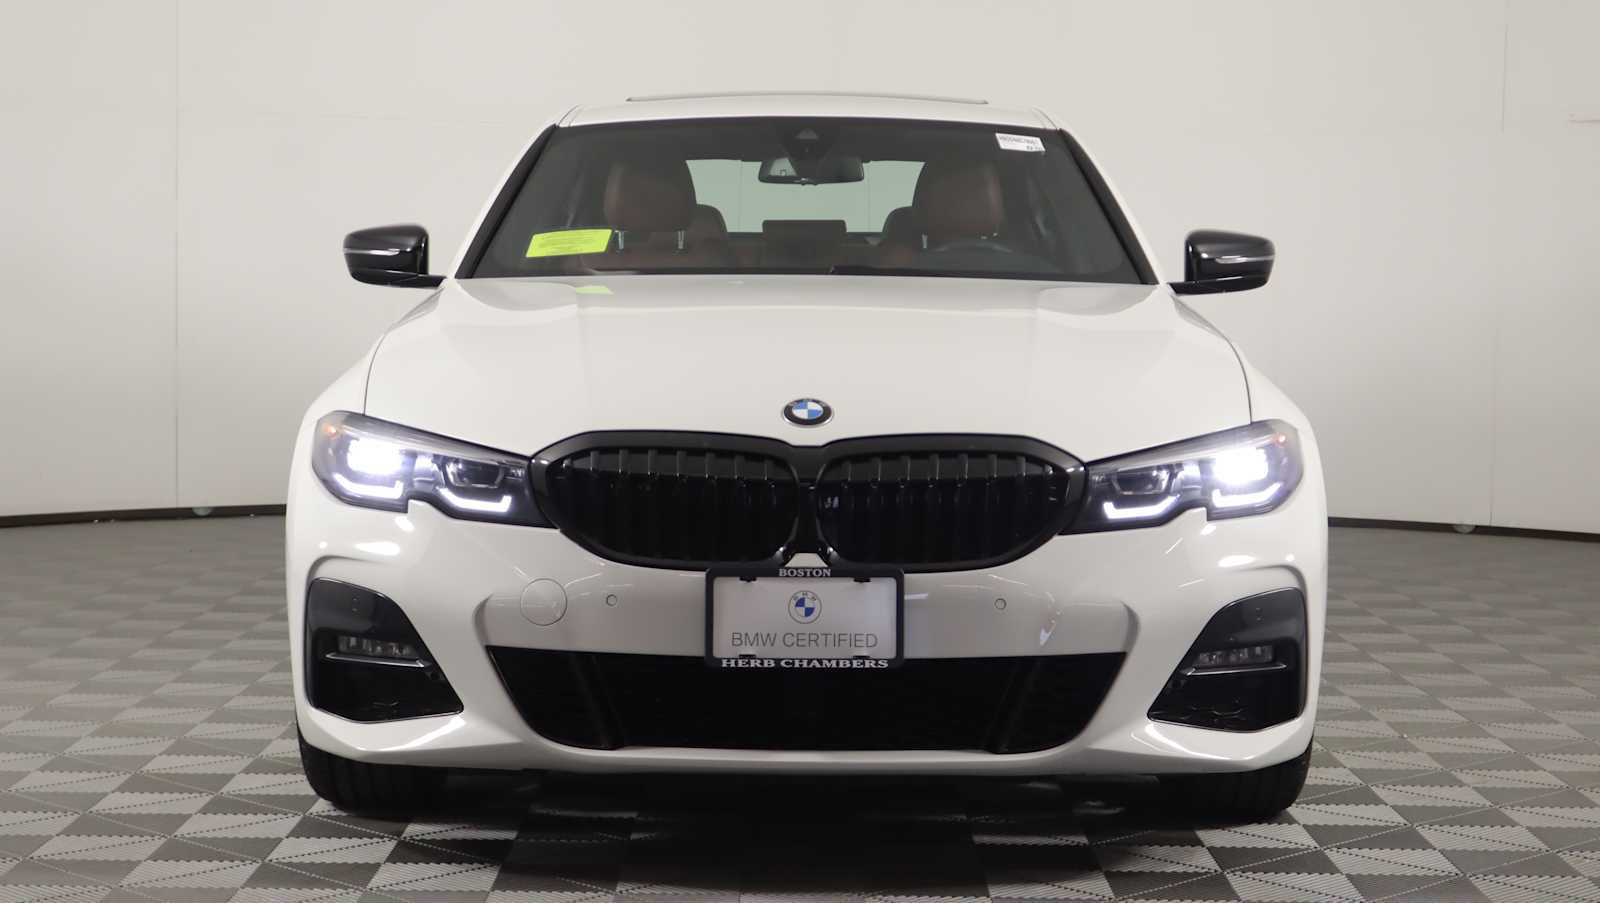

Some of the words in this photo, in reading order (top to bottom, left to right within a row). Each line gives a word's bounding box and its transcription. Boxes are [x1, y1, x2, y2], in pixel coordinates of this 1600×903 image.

[779, 569, 831, 577] BOSTON
[731, 632, 777, 647] BMW
[782, 633, 878, 648] CERTIFIED
[721, 659, 775, 668] HERB
[780, 659, 889, 669] CHAMBERS
